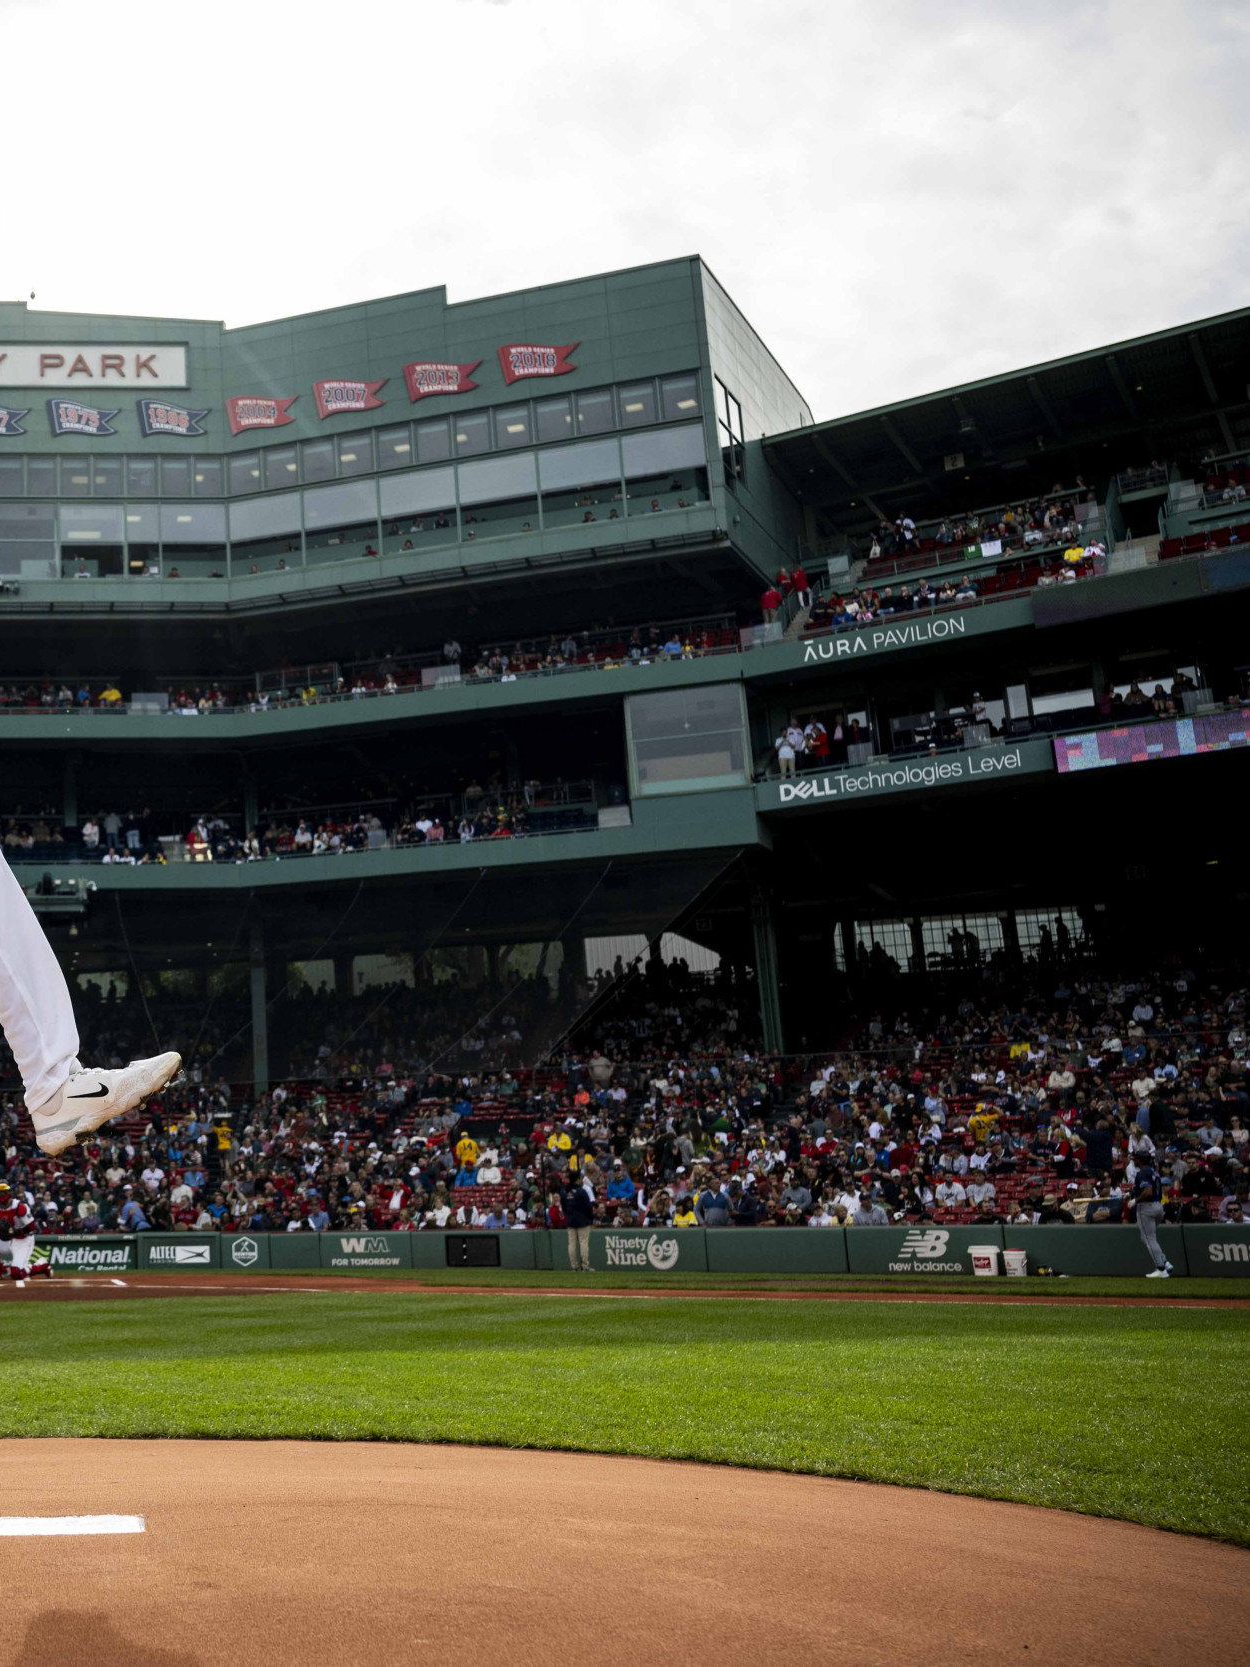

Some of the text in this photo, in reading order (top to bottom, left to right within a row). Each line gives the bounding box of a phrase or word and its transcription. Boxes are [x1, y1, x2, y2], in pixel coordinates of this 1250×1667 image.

[39, 353, 158, 378] PARK
[509, 353, 557, 370] 2018
[415, 370, 460, 387] 2013
[322, 388, 367, 405] 2007
[59, 407, 100, 428] 1975
[148, 408, 190, 428] 1986
[236, 405, 278, 420] 2004
[872, 616, 966, 649] PAVILION
[779, 748, 1022, 802] DELL Technologies Level
[340, 1236, 391, 1253] WM
[605, 1235, 648, 1251] Ninety
[50, 1245, 130, 1264] National
[149, 1246, 176, 1259] ALTEC
[606, 1248, 647, 1266] Nine
[1208, 1242, 1250, 1263] sm
[331, 1256, 401, 1267] FOR TOMORROW
[888, 1262, 912, 1272] new
[913, 1260, 963, 1272] balance
